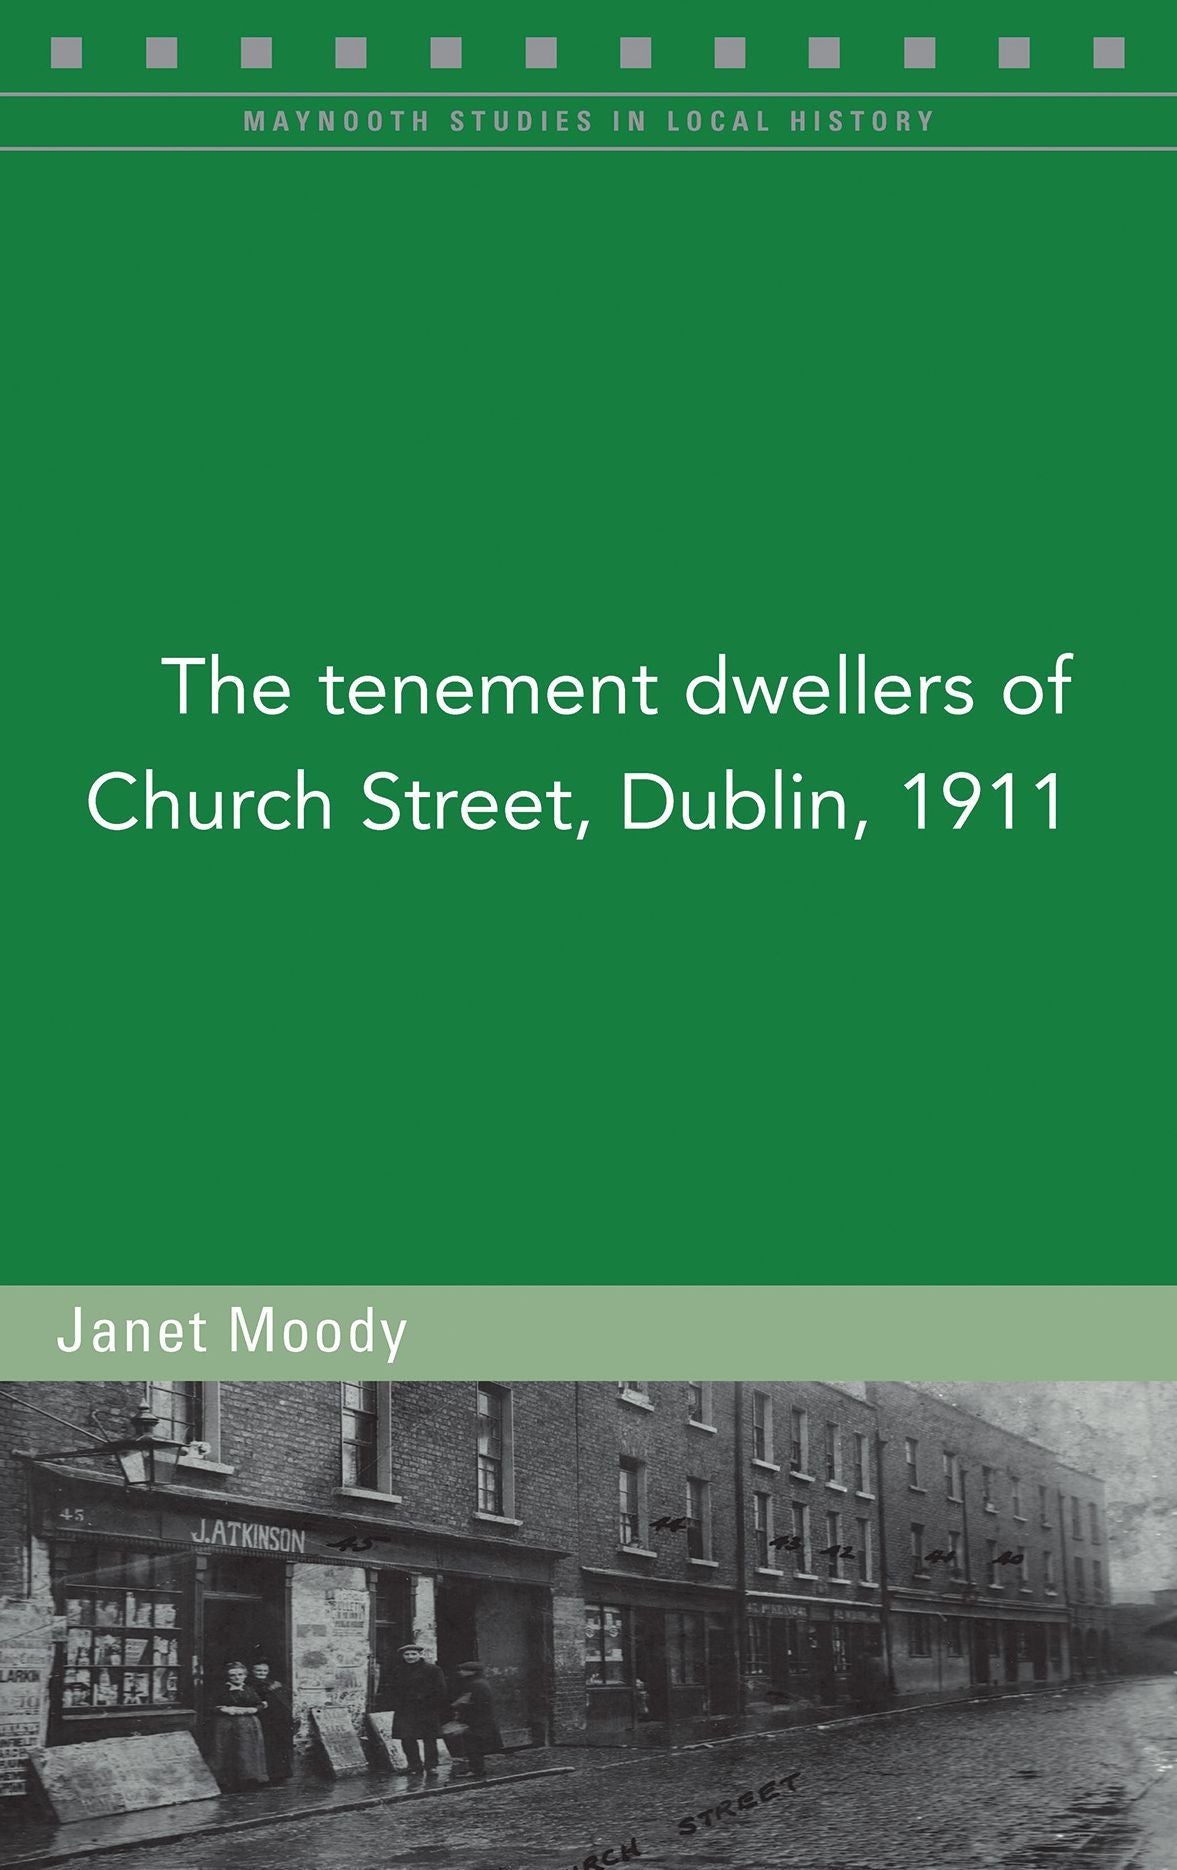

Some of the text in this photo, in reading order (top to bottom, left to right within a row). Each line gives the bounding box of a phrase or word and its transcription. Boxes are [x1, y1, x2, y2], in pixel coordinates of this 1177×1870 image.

[244, 110, 934, 132] MAYNOOTH STUDIES IN LOCAL HISTORY
[160, 652, 1074, 716] The tenement dwellers of
[87, 768, 1060, 841] Church Street, Dublin, 1911
[57, 1306, 408, 1364] Janet Moody
[59, 1507, 84, 1521] 45
[191, 1518, 306, 1553] J.ATKINSON
[677, 1772, 800, 1836] STREET
